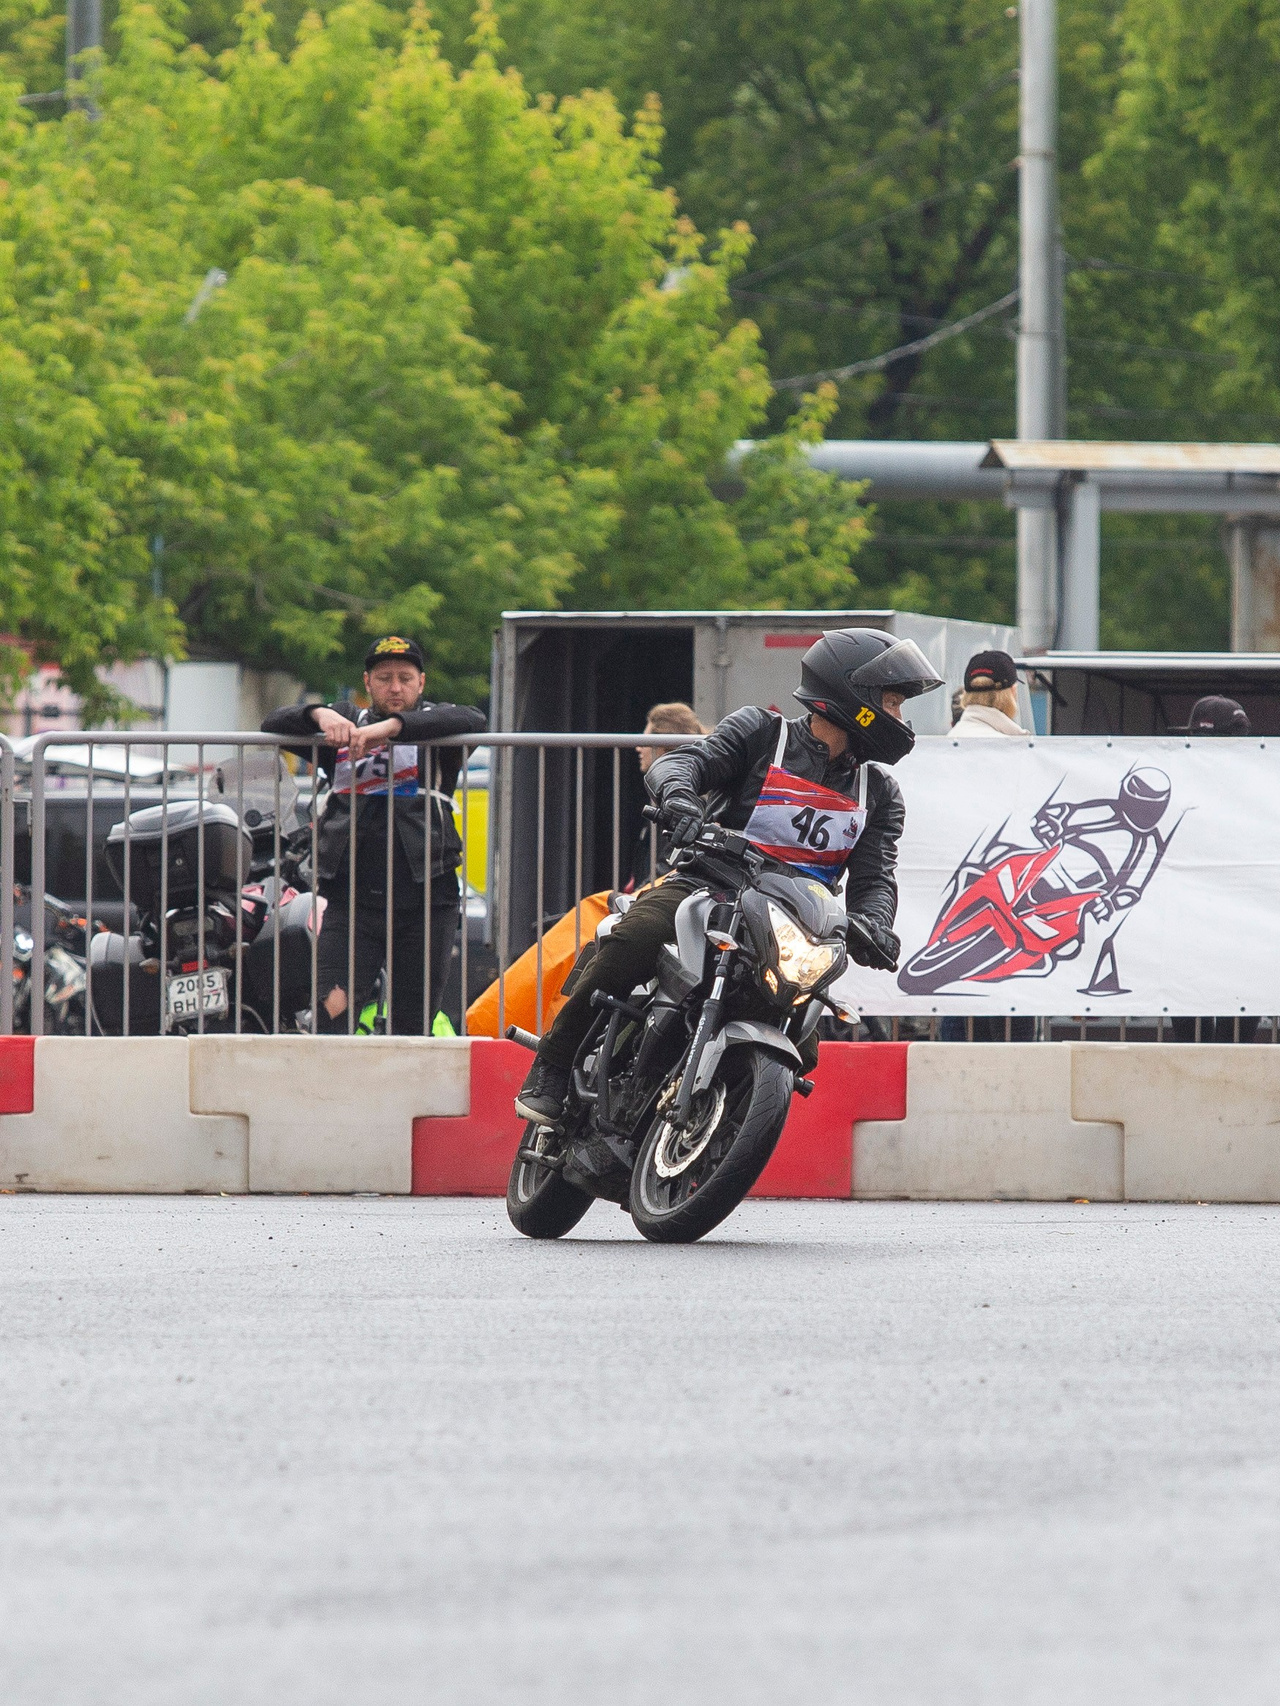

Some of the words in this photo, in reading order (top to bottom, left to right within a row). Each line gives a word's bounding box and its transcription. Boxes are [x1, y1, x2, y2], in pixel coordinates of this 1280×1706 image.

[855, 706, 875, 727] 13
[791, 805, 834, 851] 46
[177, 975, 215, 995] 205
[202, 993, 221, 1007] 77
